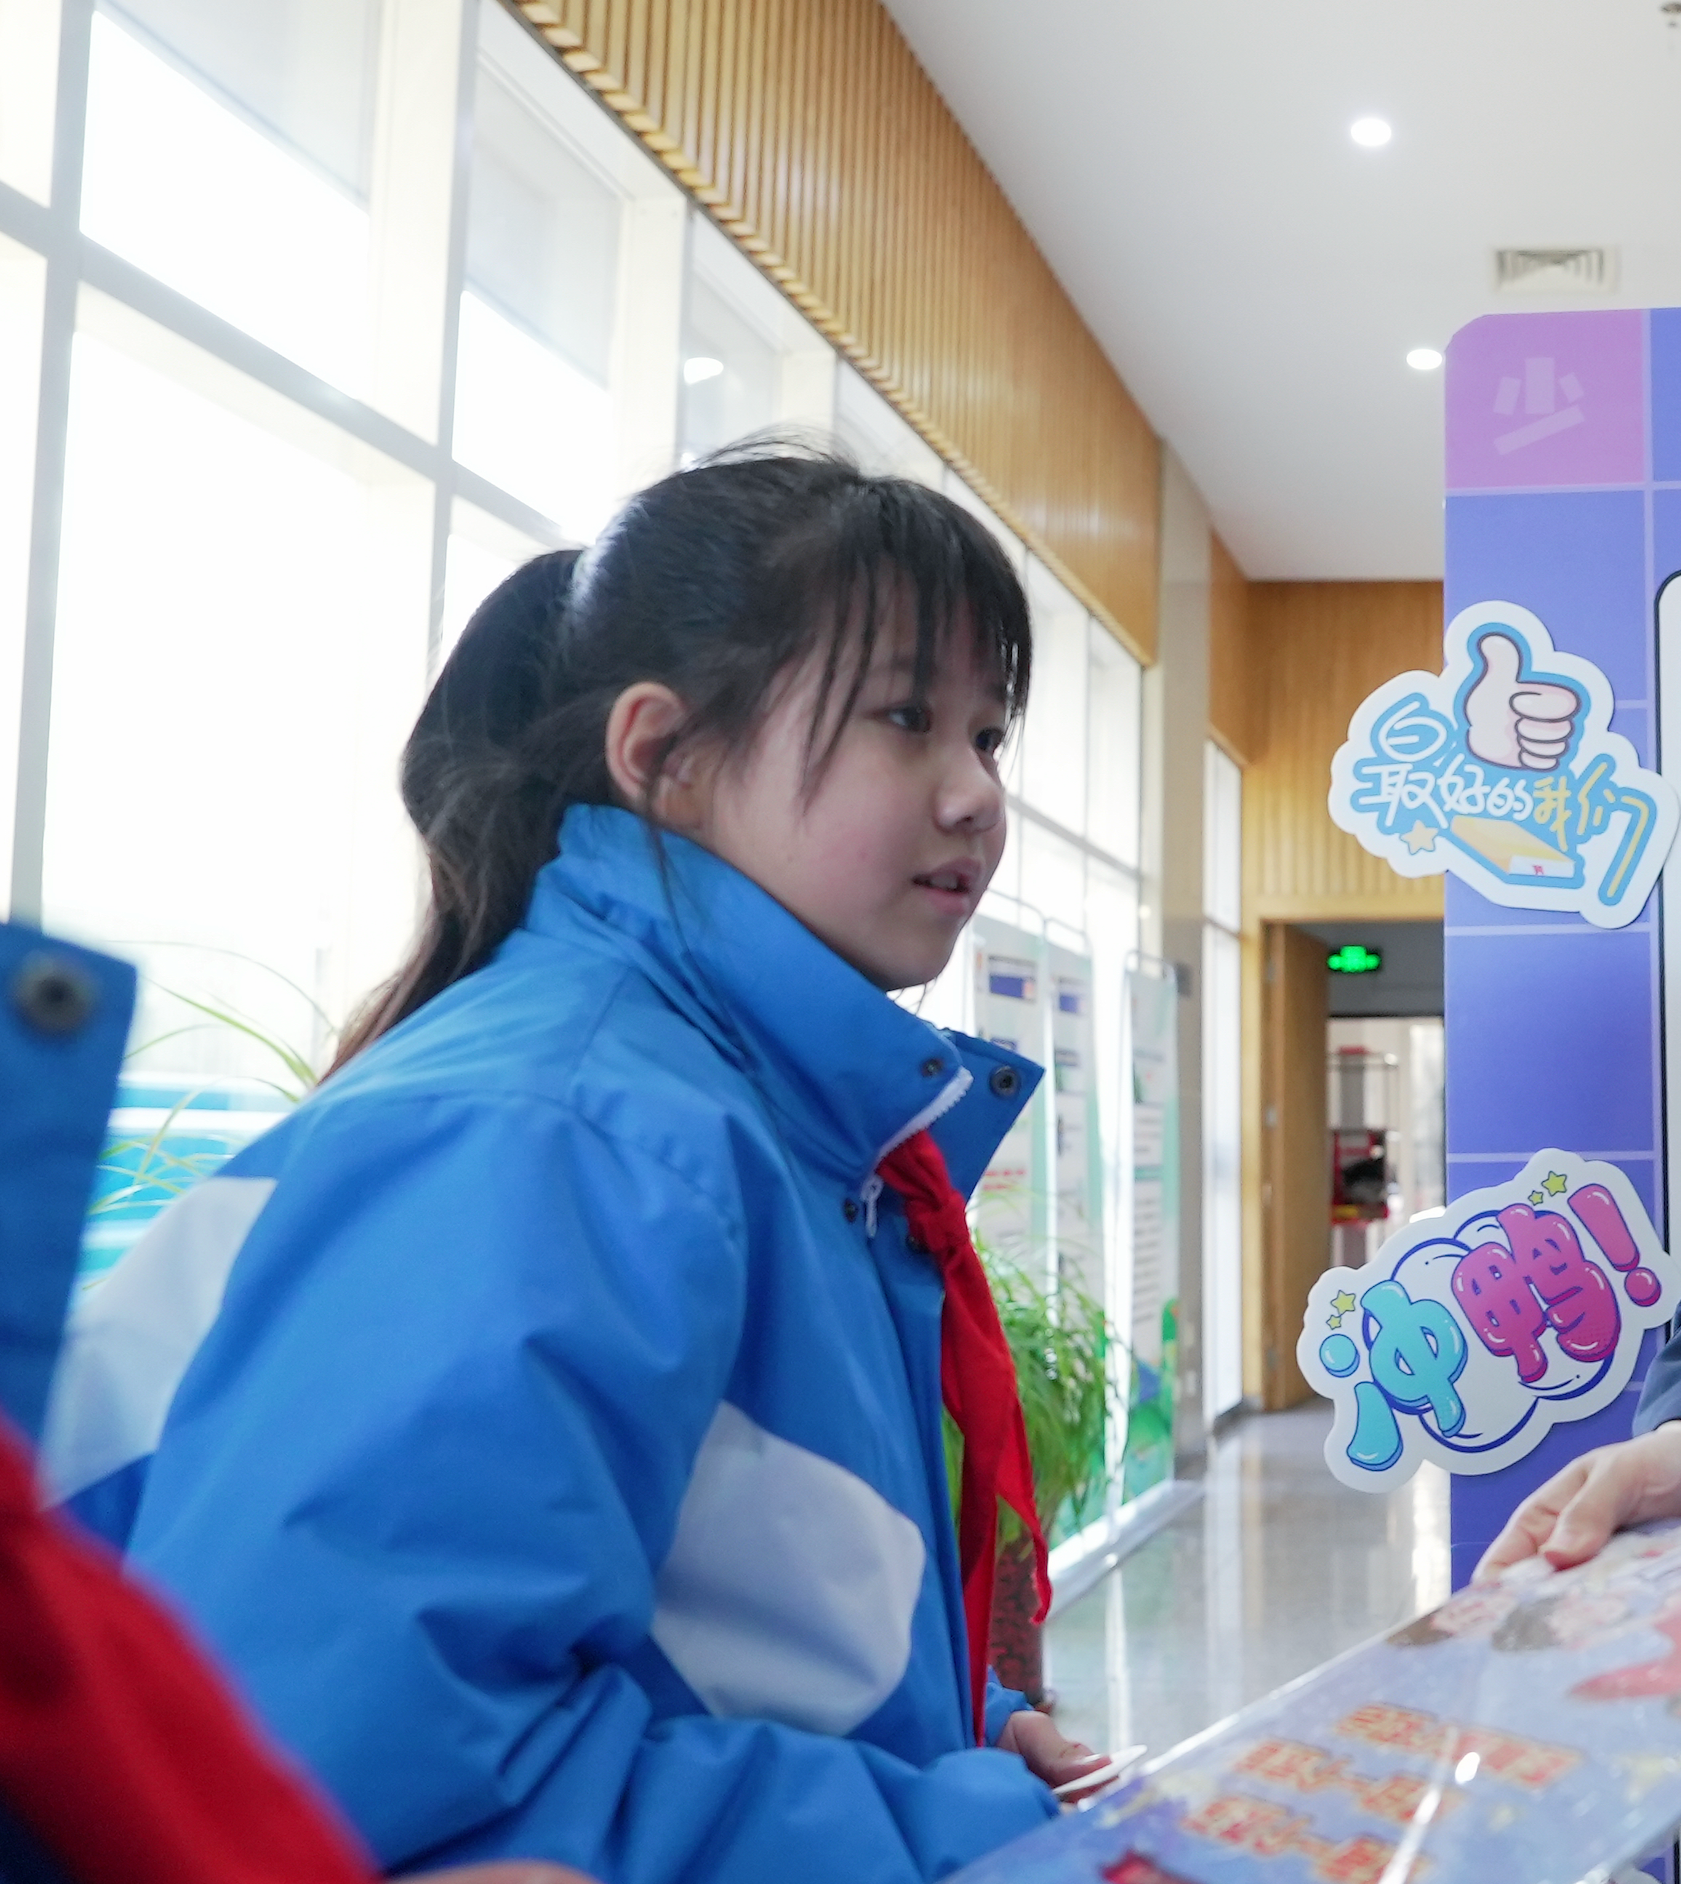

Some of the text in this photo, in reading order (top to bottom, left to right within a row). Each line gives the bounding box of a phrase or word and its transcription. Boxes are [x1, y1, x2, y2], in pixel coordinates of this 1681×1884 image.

[1491, 356, 1588, 457] 少
[1358, 701, 1650, 900] 最好的我们
[1319, 1183, 1662, 1472] 冲鸭!
